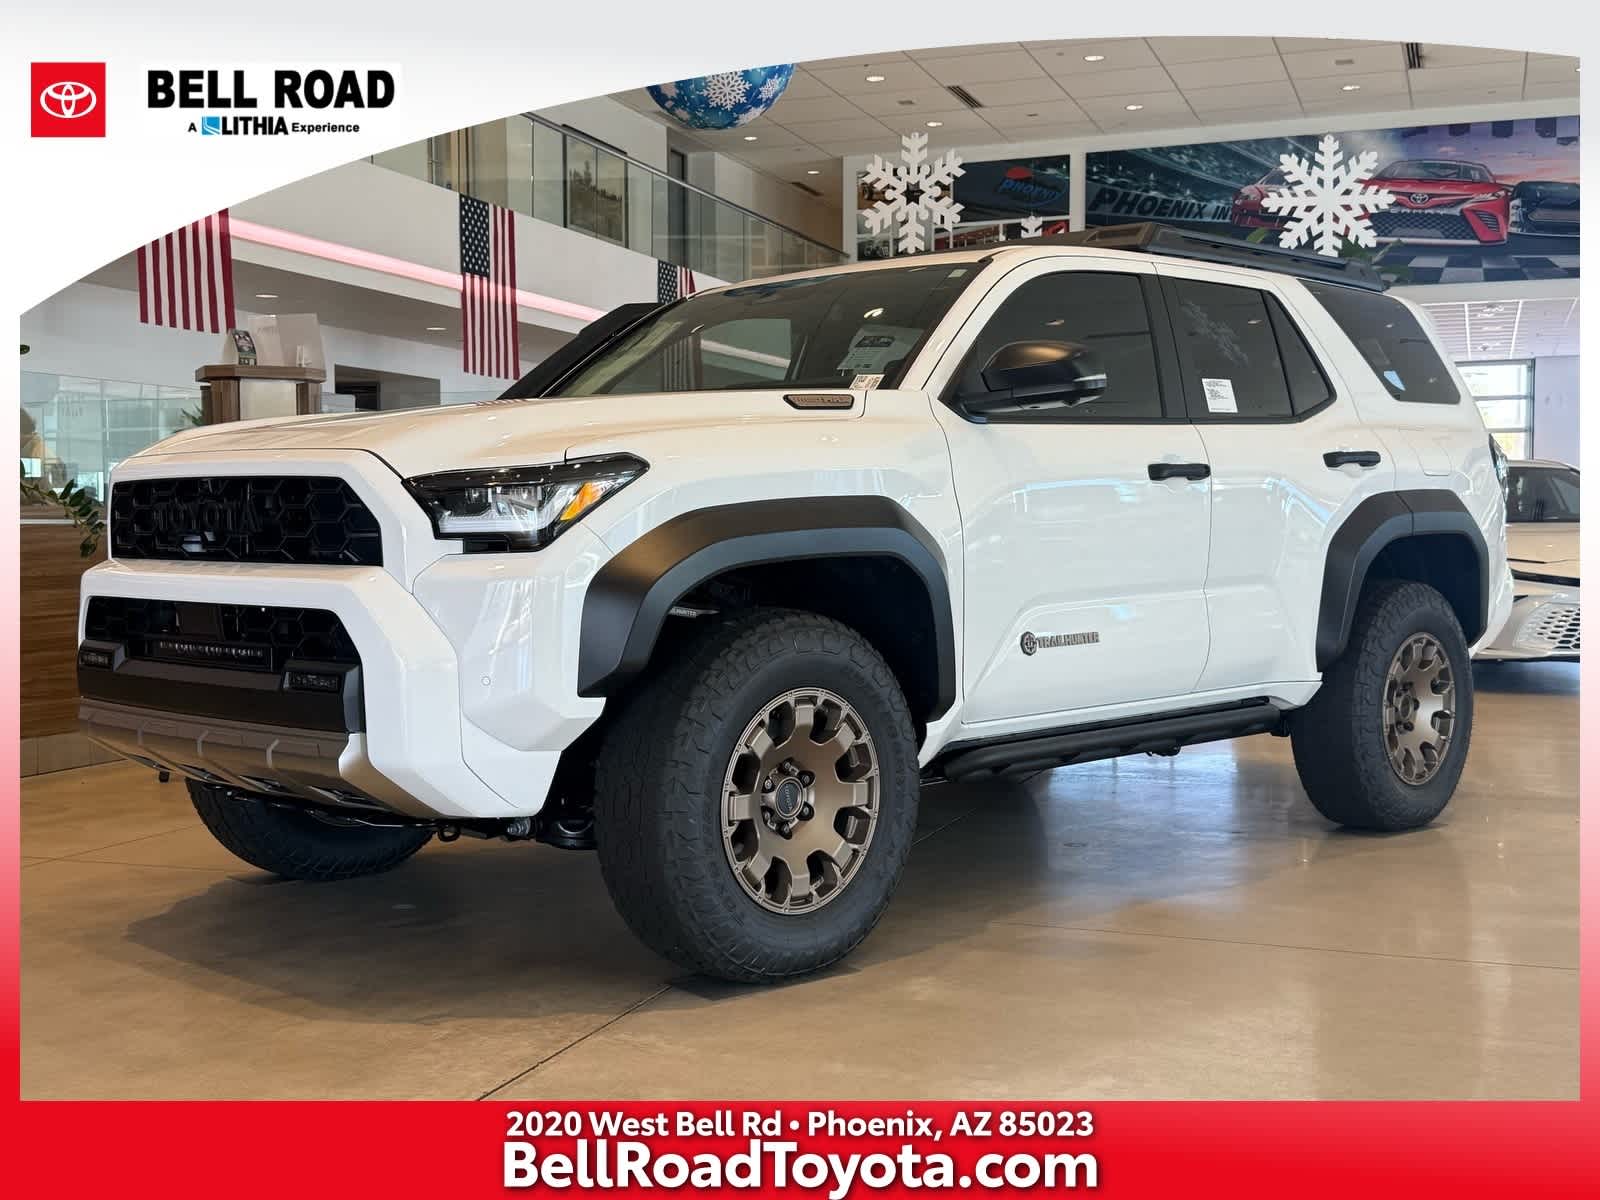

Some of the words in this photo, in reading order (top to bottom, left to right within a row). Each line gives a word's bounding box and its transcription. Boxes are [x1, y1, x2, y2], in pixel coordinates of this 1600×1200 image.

[1089, 186, 1206, 220] PHOENIX
[153, 499, 263, 532] TOYOTA
[1036, 631, 1100, 648] TRAILHUNTER
